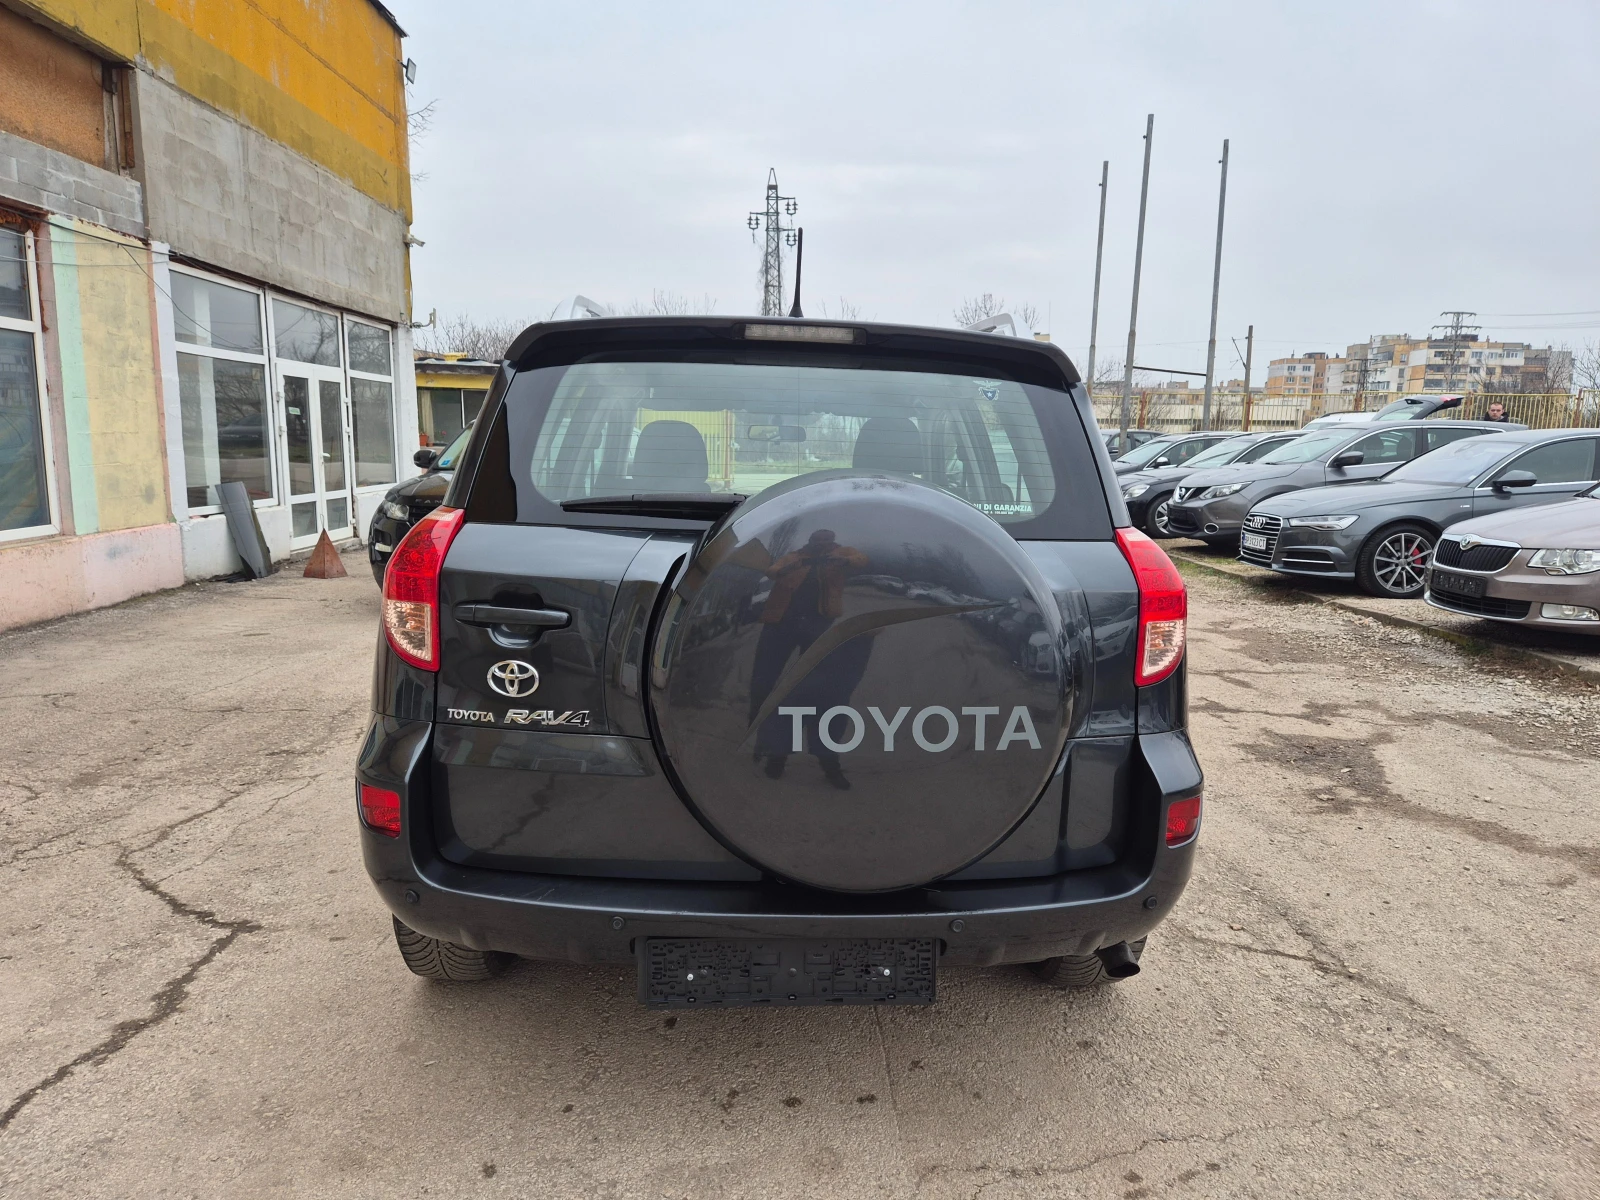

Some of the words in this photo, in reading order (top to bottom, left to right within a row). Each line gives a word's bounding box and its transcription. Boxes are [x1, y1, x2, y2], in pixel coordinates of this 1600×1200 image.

[994, 504, 1032, 512] GARANZIA
[447, 708, 495, 723] TOYOTA
[504, 708, 590, 728] RAV4
[777, 705, 1042, 753] TOYOTA
